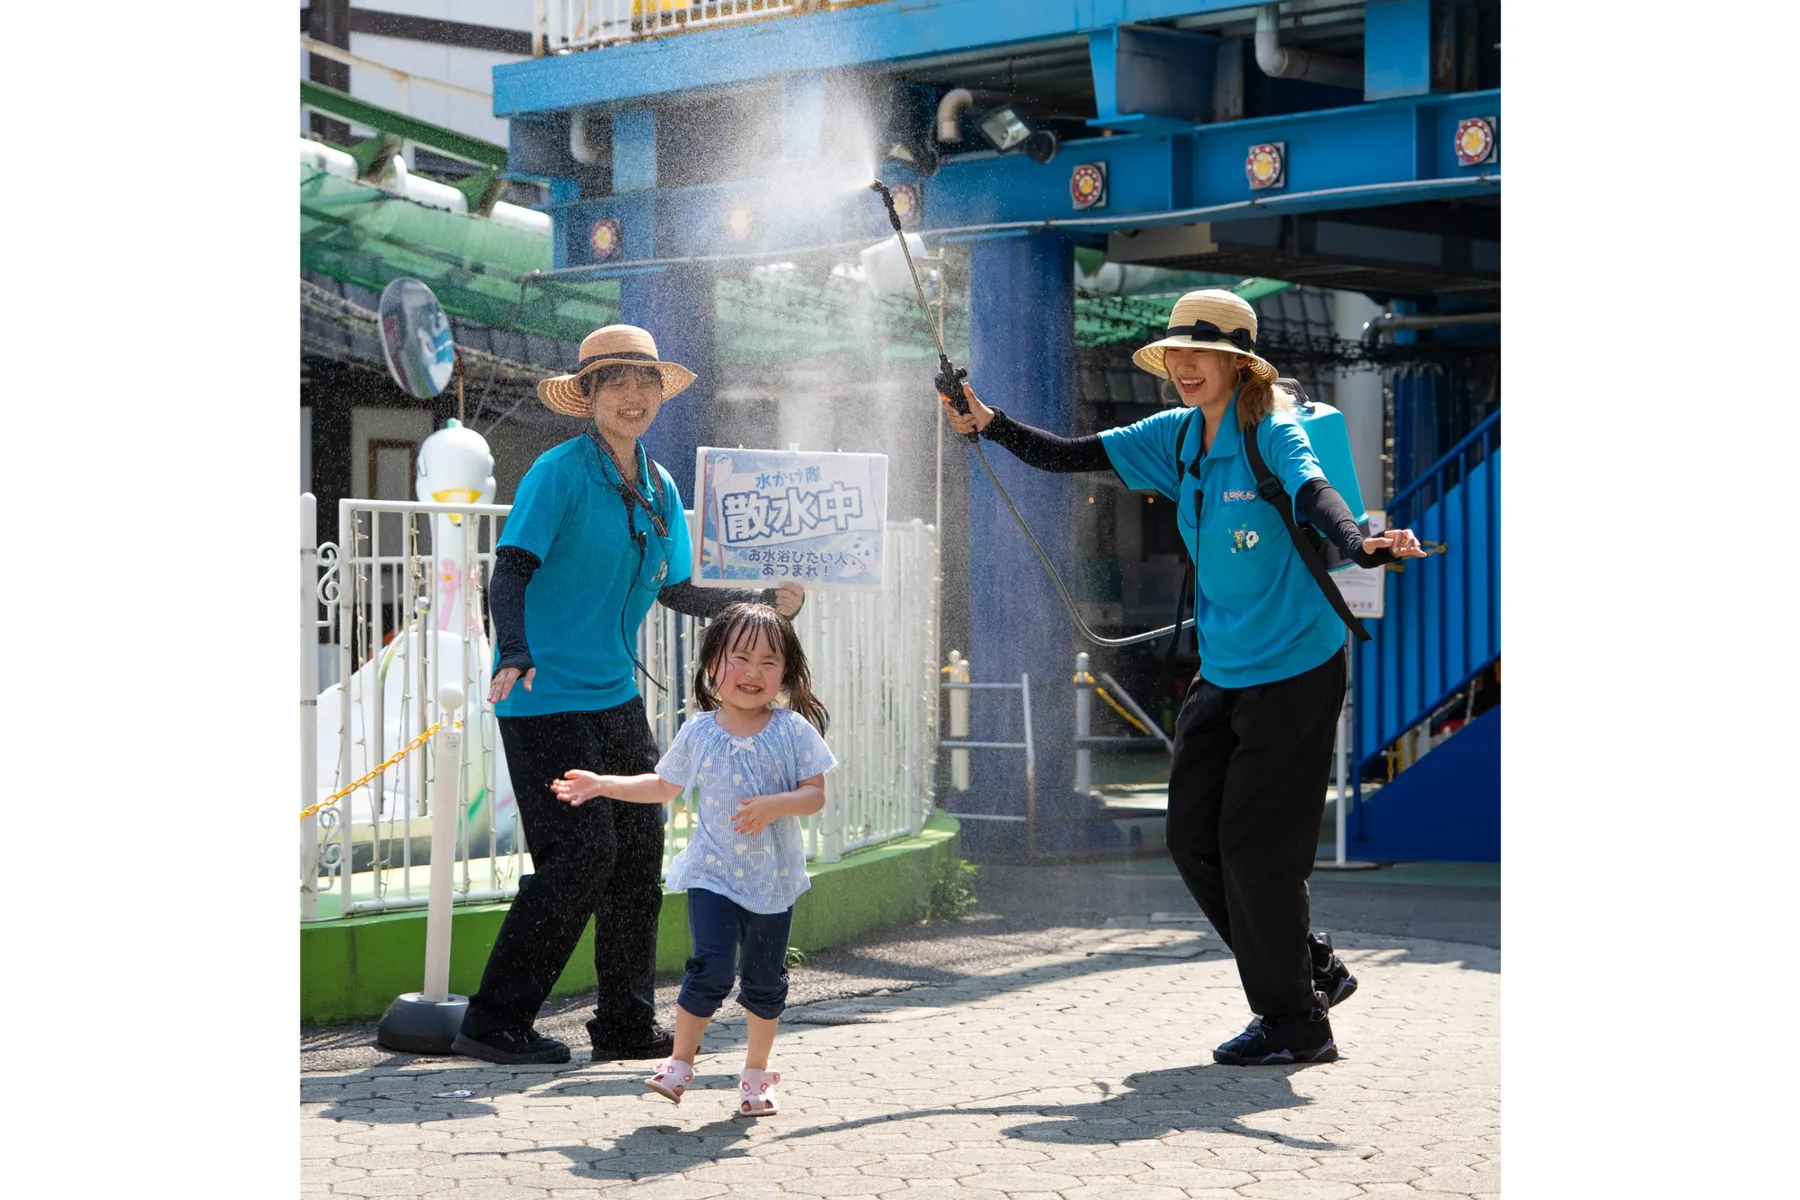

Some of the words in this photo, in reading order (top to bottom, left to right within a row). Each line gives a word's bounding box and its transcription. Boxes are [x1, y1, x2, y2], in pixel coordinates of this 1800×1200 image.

[755, 466, 822, 489] 水かけ隊
[722, 481, 863, 543] 散水中
[748, 549, 847, 566] お水浴びたい人
